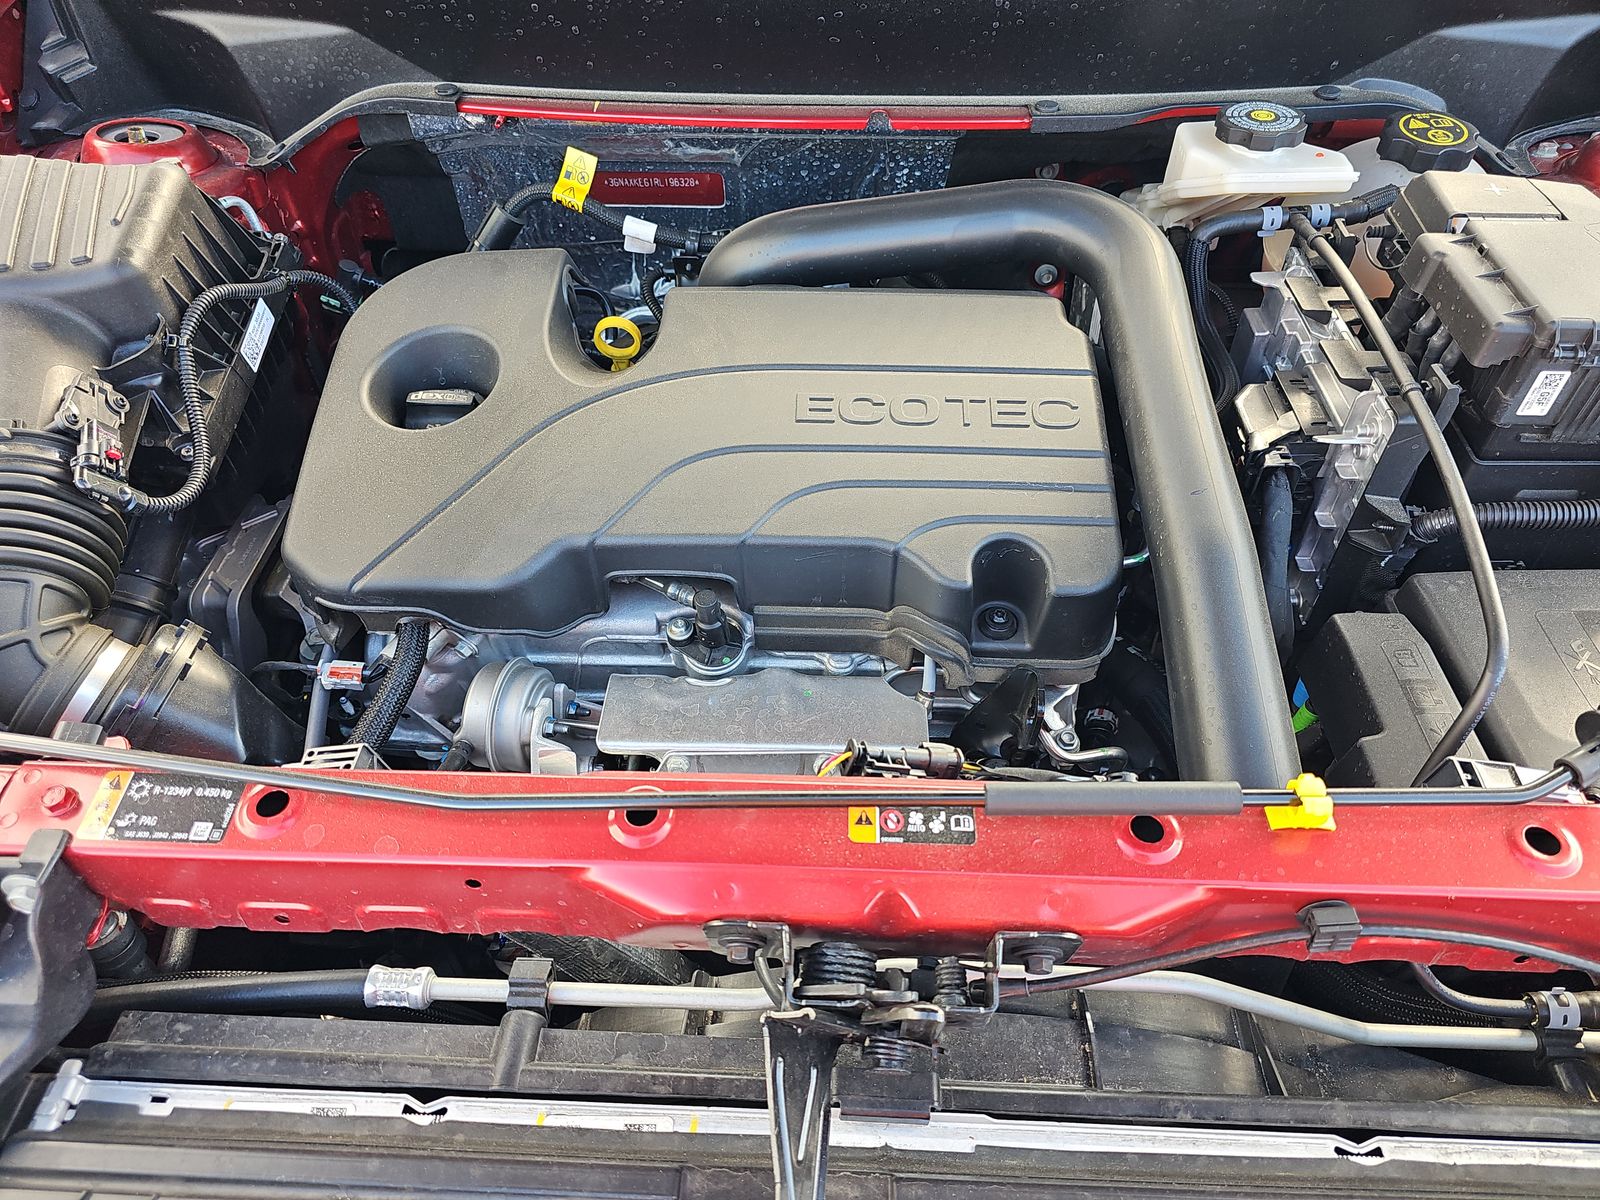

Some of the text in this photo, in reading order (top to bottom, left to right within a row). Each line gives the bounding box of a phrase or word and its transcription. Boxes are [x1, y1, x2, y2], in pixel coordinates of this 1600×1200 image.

[795, 393, 1081, 430] ECOTEC
[153, 785, 233, 799] R-1234yf 0.450 kg
[138, 815, 158, 826] PAG
[907, 824, 926, 833] AUTO
